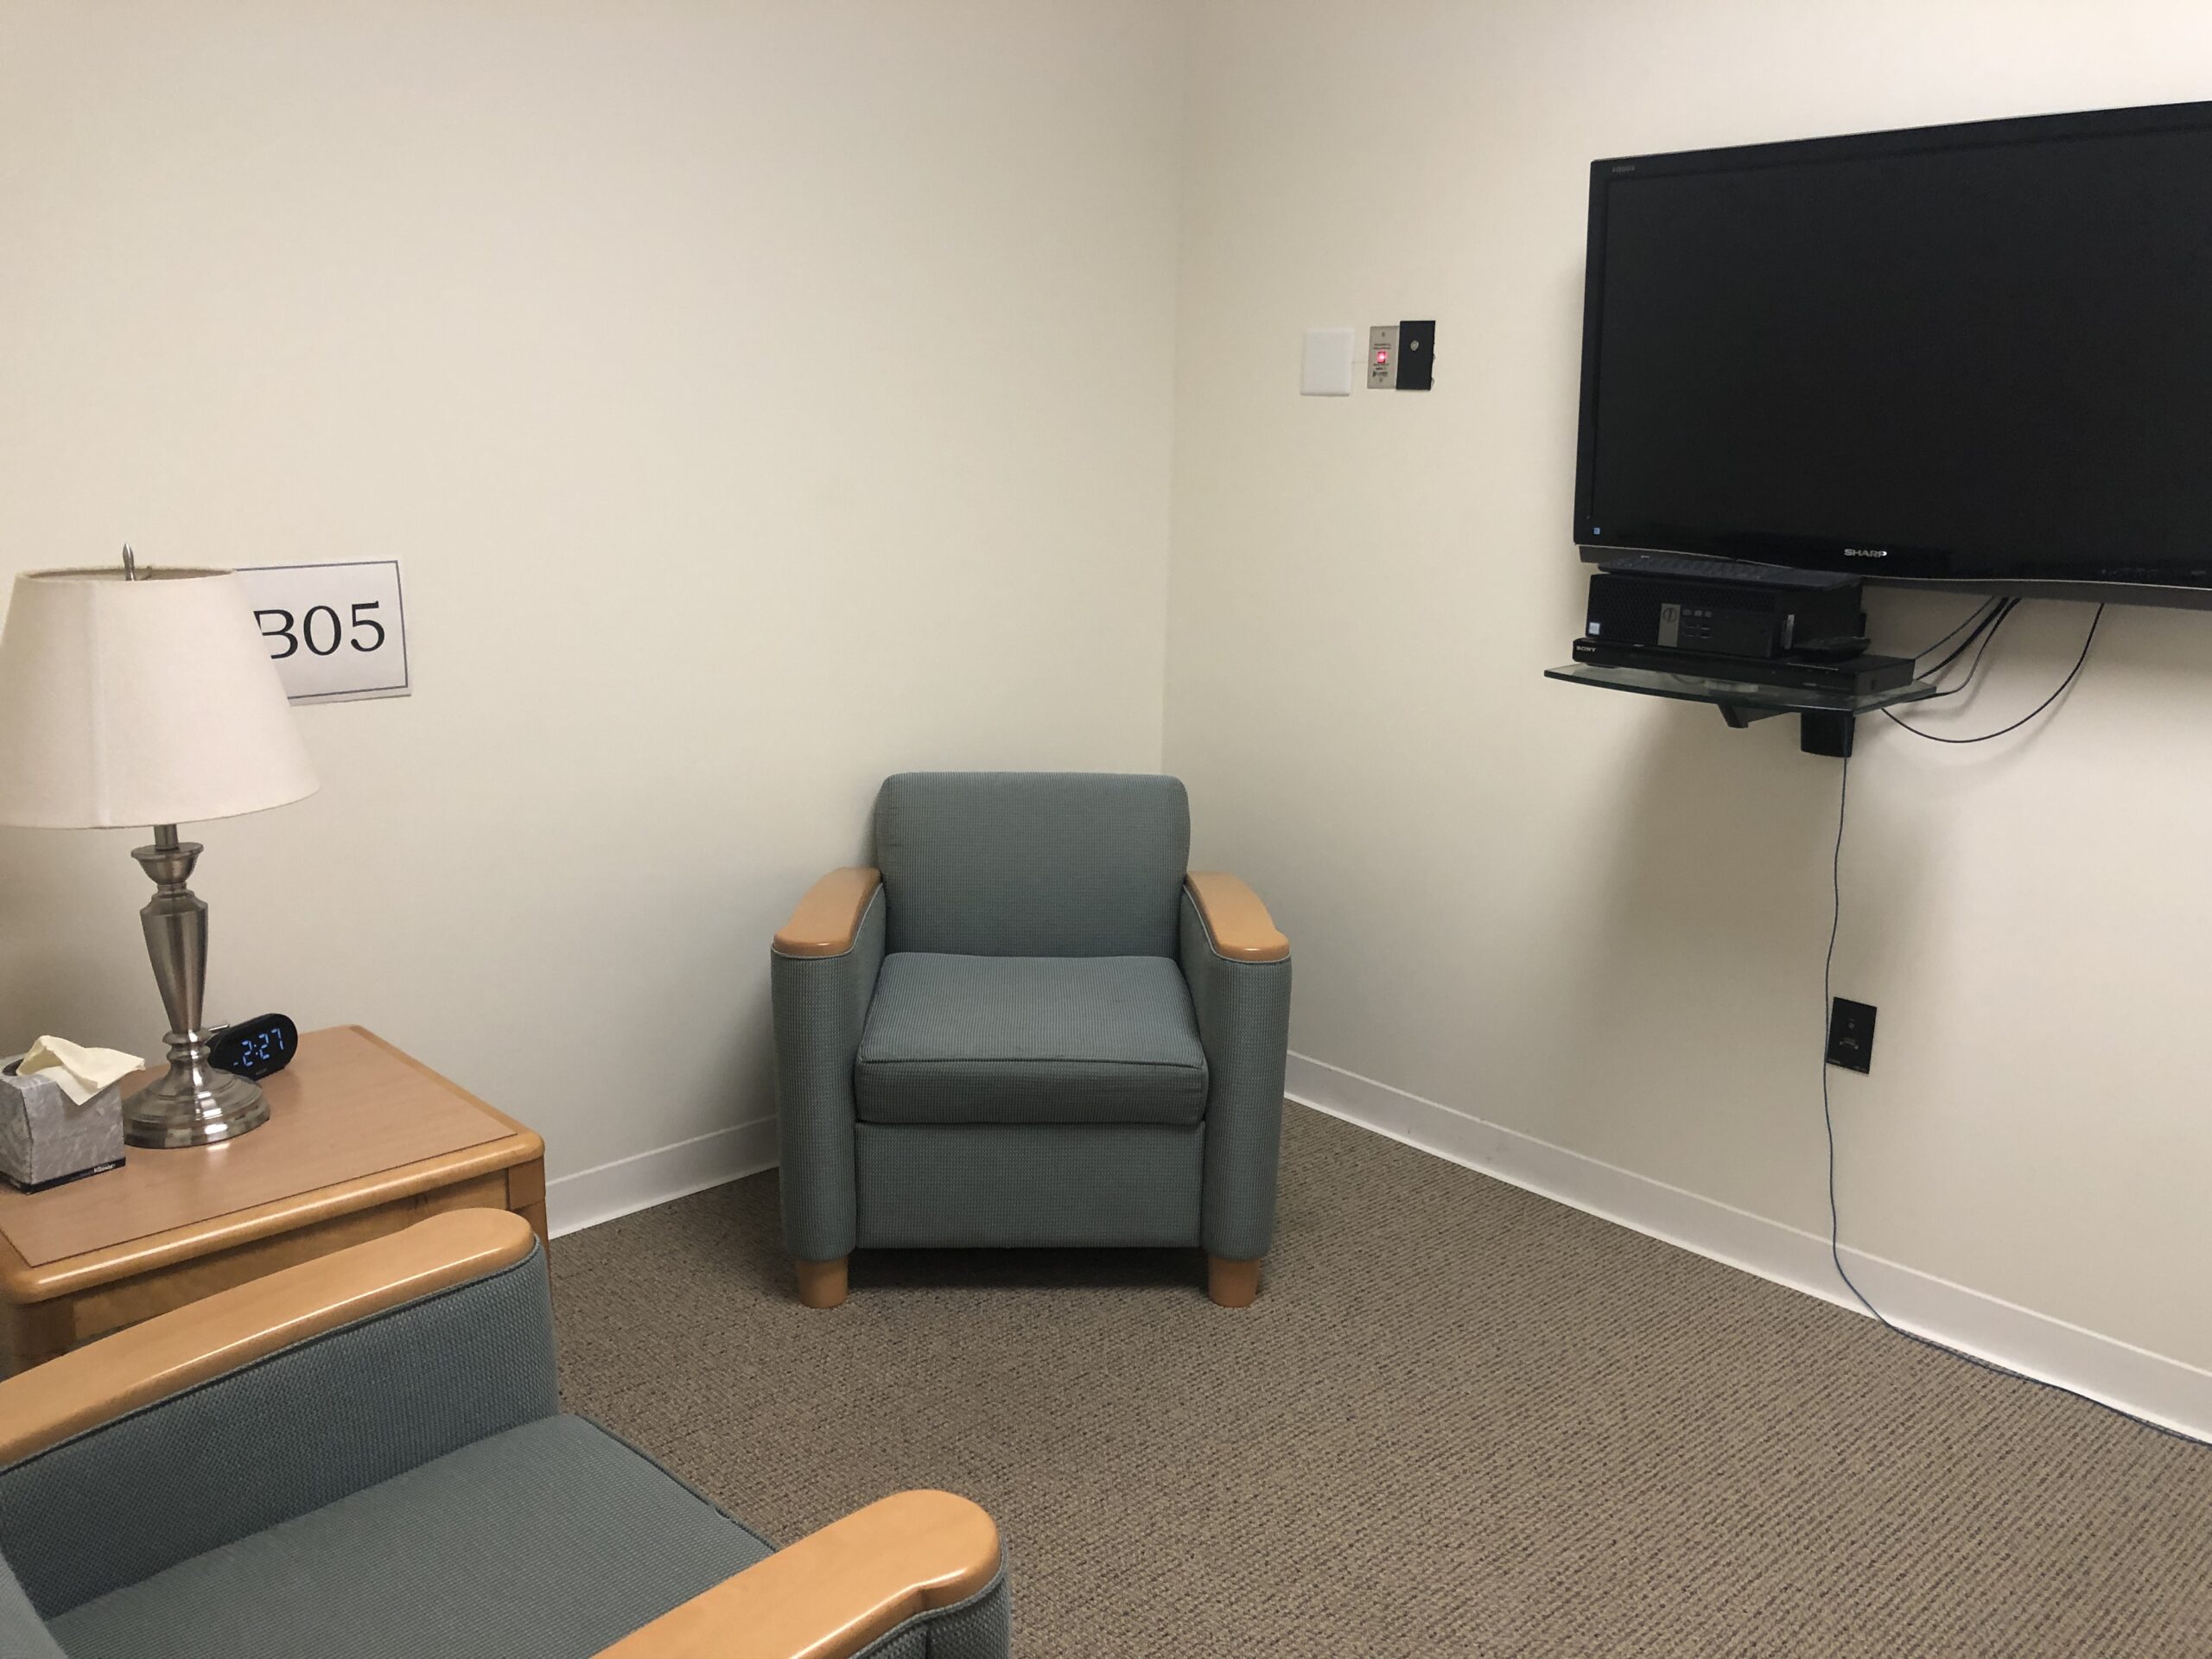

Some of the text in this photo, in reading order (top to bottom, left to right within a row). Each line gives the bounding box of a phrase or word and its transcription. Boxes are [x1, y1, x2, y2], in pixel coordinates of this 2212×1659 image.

[1844, 549, 1887, 558] SHARP
[253, 601, 385, 658] B05
[242, 1028, 283, 1066] 2:27
